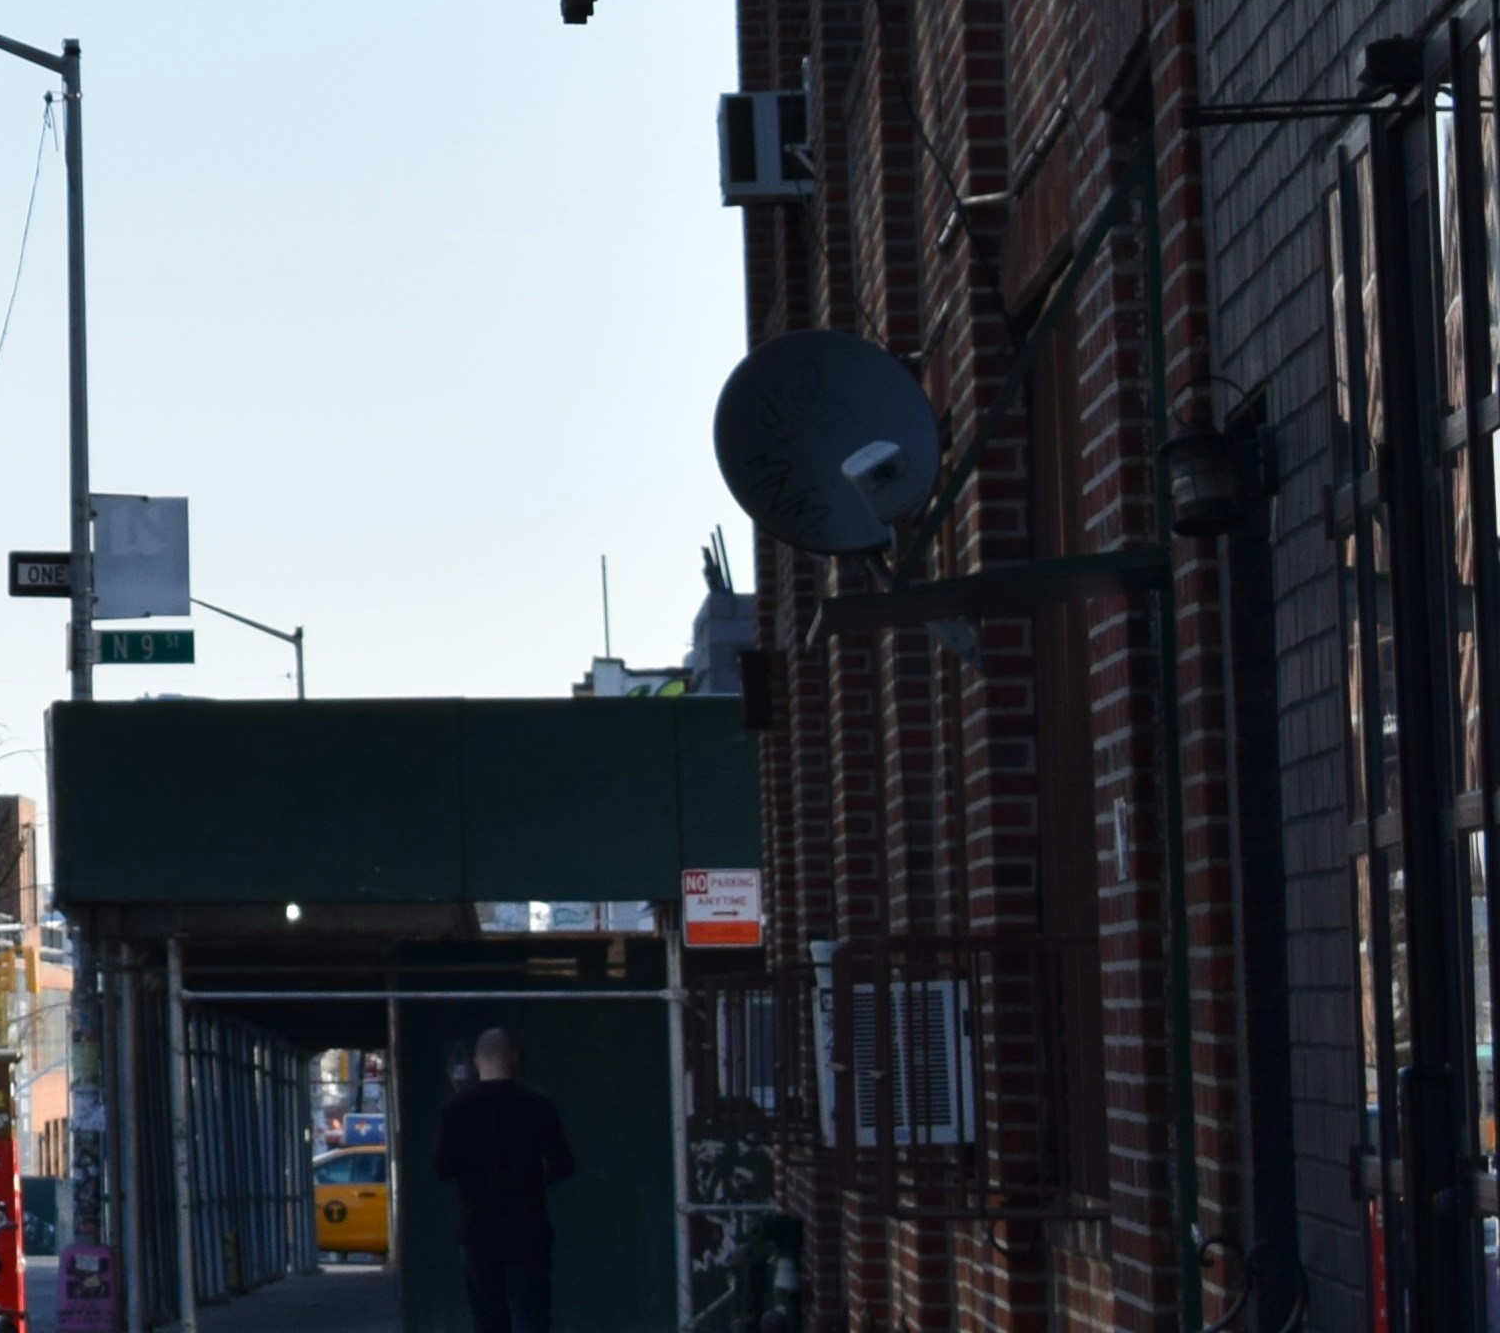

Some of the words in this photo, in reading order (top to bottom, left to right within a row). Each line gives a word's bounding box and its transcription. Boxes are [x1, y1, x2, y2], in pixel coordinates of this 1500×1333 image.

[27, 565, 66, 584] ONE
[113, 635, 128, 659] N
[141, 634, 155, 660] 9
[166, 633, 180, 648] St
[685, 874, 708, 892] NO
[710, 877, 754, 887] PARKING
[697, 895, 747, 906] ANYTIME
